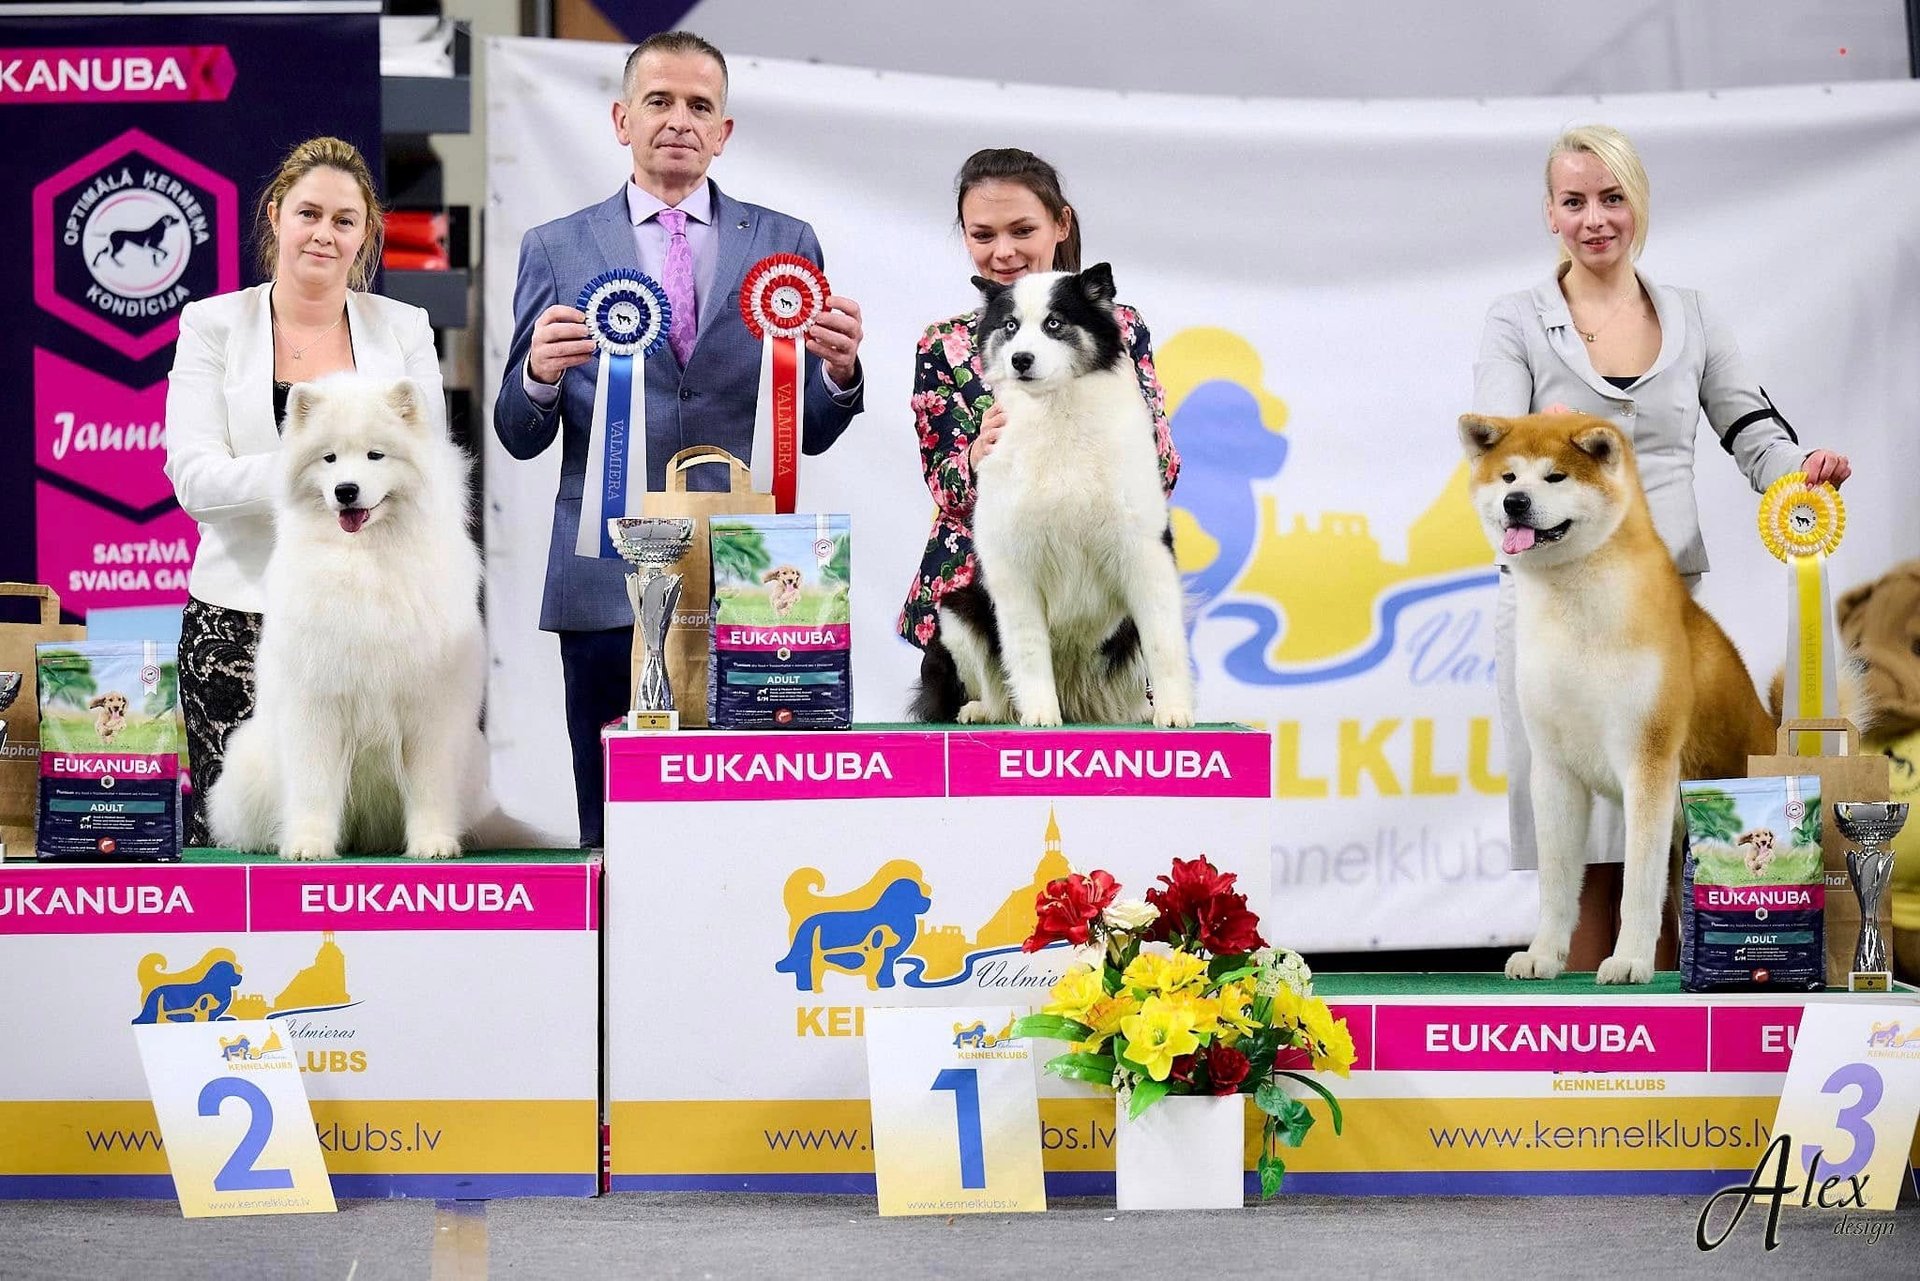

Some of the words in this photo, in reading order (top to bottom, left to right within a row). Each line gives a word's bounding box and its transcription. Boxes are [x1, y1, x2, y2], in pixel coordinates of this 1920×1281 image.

[0, 57, 187, 92] KANUBA
[53, 412, 167, 460] Jaunu
[778, 382, 793, 477] VALMIERA
[608, 419, 624, 501] VALMIERA
[69, 571, 150, 591] SVAIGA
[730, 630, 836, 646] EUKANUBA
[766, 675, 801, 684] ADULT
[53, 757, 162, 774] EUKANUBA
[660, 752, 893, 782] EUKANUBA
[999, 749, 1232, 779] EUKANUBA
[90, 804, 124, 812] ADULT
[0, 885, 194, 915] UKANUBA
[301, 883, 535, 913] EUKANUBA
[1708, 890, 1811, 906] EUKANUBA
[1744, 935, 1778, 944] ADULT
[977, 961, 1064, 988] Valmie
[286, 1019, 356, 1038] almieras
[1426, 1023, 1656, 1053] EUKANUBA
[228, 1062, 293, 1071] KENNELKLUBS
[958, 1051, 1028, 1060] KENNELKLUBS
[1553, 1079, 1666, 1091] KENNELKLUBS
[197, 1076, 295, 1192] 2
[931, 1067, 986, 1190] 1
[1801, 1062, 1884, 1183] 3
[209, 1197, 310, 1209] www.kennelklubs.lv
[907, 1199, 1018, 1209] www.kennelklubs.lv
